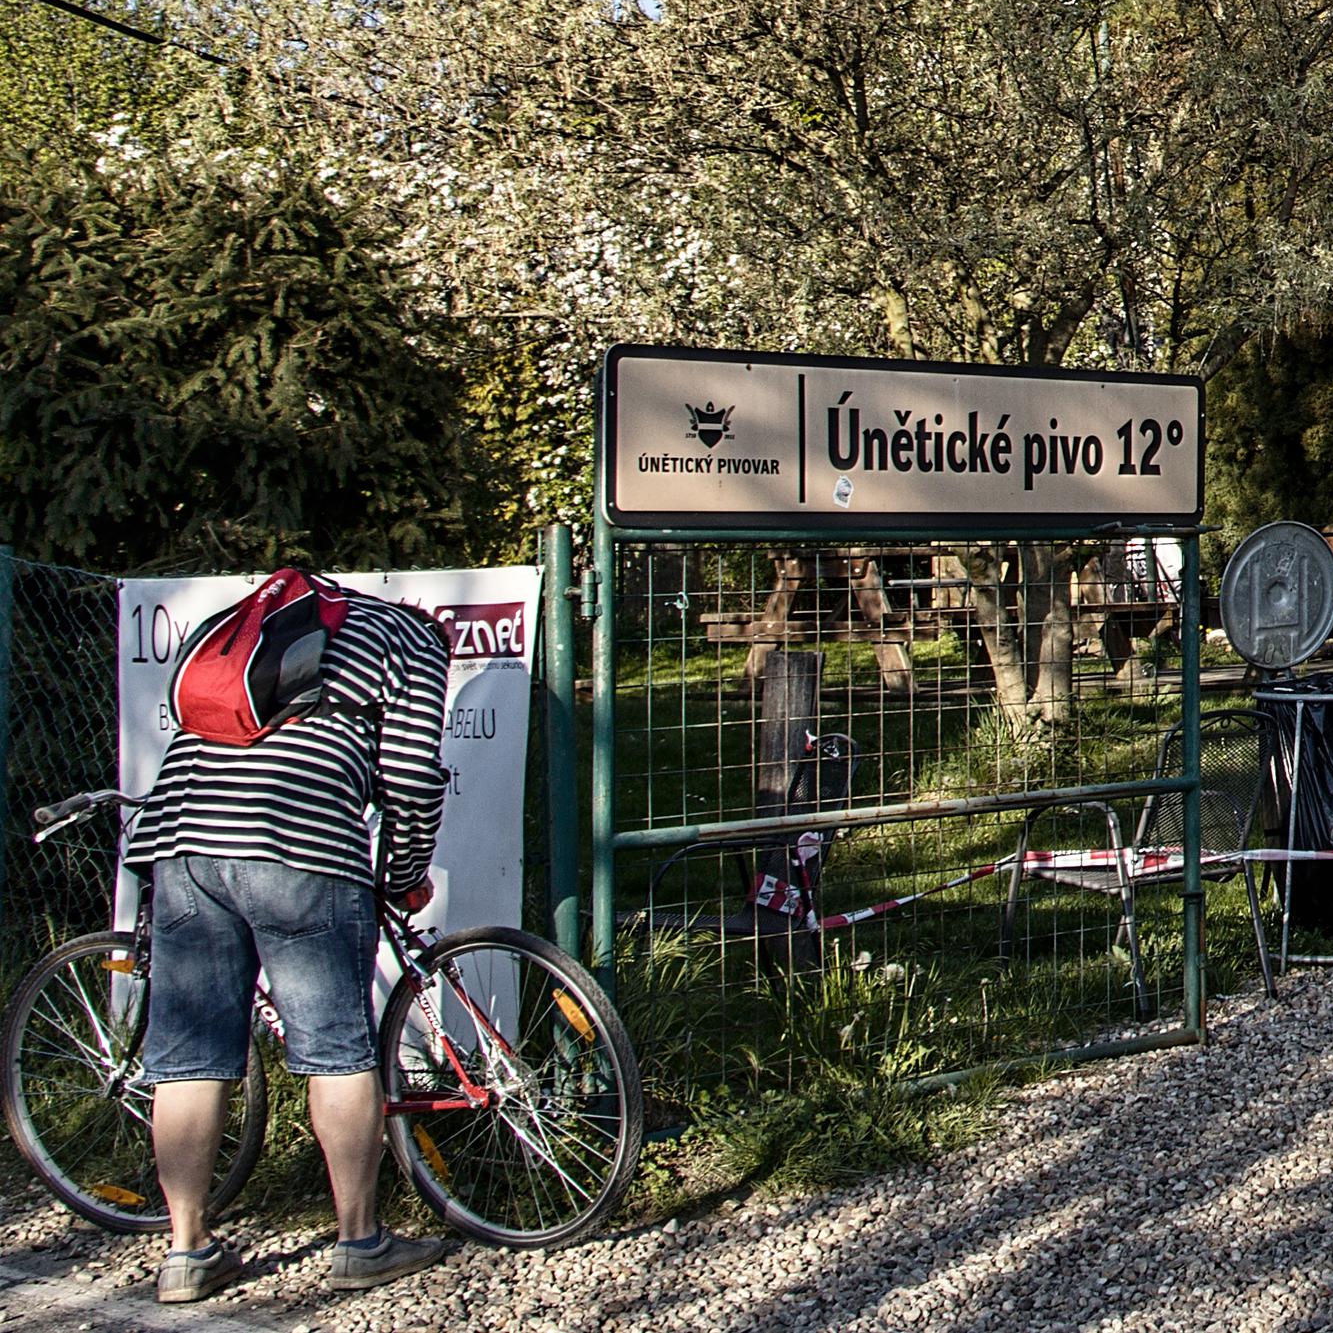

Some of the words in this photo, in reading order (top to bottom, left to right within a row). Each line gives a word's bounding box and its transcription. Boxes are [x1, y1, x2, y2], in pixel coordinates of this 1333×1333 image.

[638, 452, 713, 473] ÚNĚTICKÝ
[717, 456, 780, 475] PIVOVAR
[827, 390, 1012, 473] Únětické
[1023, 417, 1104, 491] pivo
[1116, 418, 1184, 476] 12°
